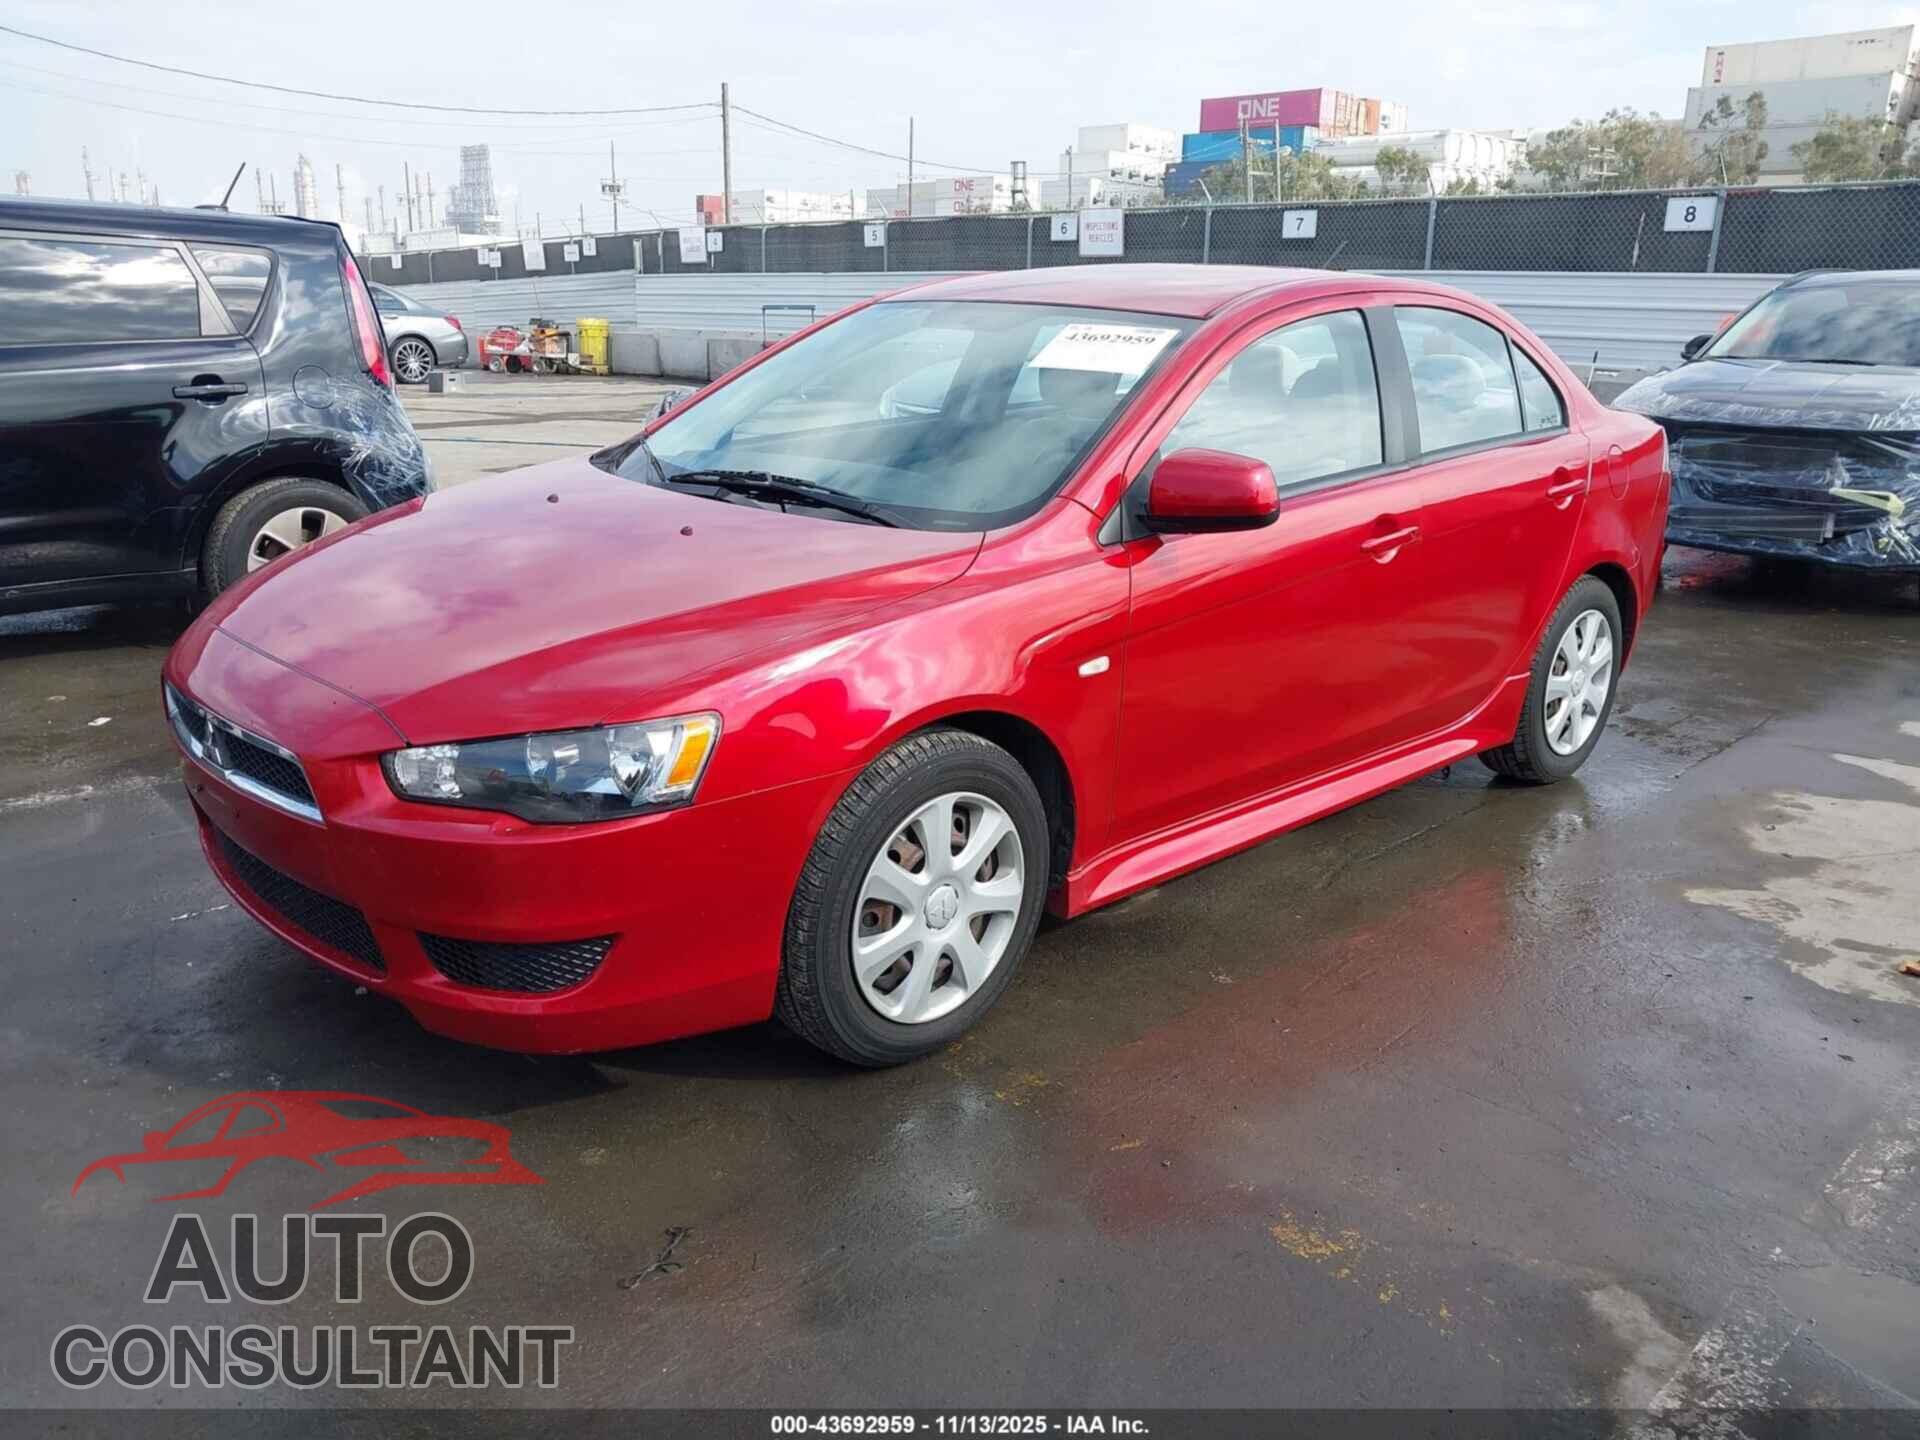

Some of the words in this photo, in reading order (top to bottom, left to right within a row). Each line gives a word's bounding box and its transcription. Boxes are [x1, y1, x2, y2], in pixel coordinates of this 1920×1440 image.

[1238, 98, 1281, 119] ONE
[954, 179, 976, 192] ONE
[1684, 205, 1697, 223] 8
[1060, 222, 1068, 235] 6
[1296, 217, 1305, 232] 7
[871, 230, 878, 241] 5
